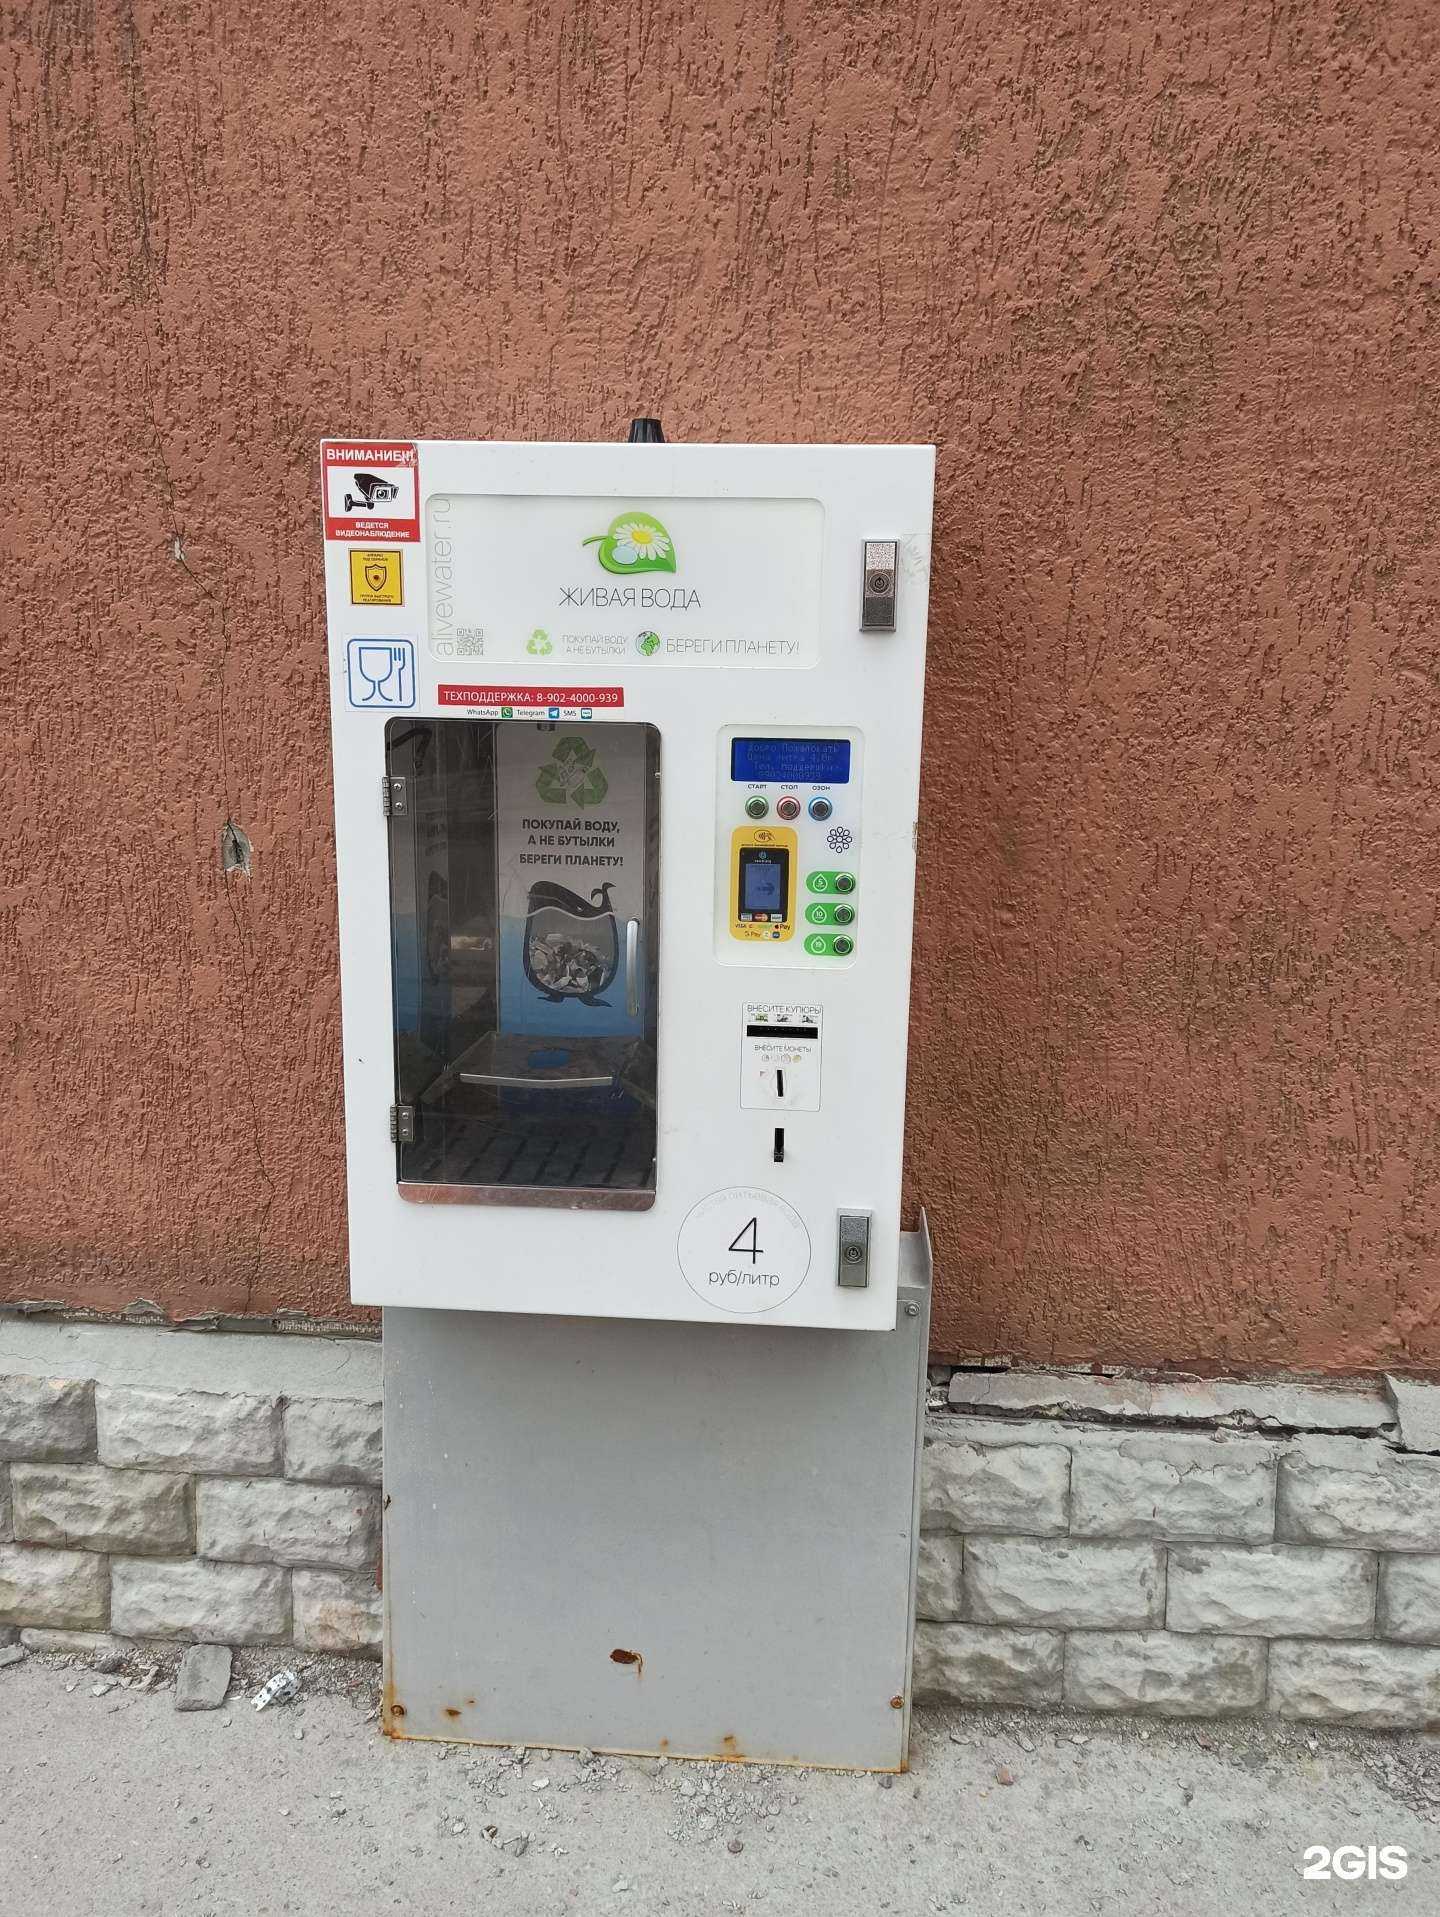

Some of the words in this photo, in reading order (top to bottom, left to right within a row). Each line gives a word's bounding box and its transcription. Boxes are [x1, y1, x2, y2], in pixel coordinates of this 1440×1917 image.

[355, 521, 389, 530] ВЕДЕТСЯ
[335, 529, 411, 539] ВИДЕОНАБЛЮДЕНИЕ
[432, 497, 453, 656] alivewater.ru
[558, 587, 636, 608] ЖИВАЯ
[641, 588, 702, 611] ВОДА
[562, 634, 604, 645] ПОКУПАЙ
[584, 647, 626, 655] БУТЫЛКИ
[666, 639, 723, 654] БЕРЕГИ
[725, 640, 799, 656] ПЛАНЕТУ!
[444, 691, 534, 703] ТЕХПОДДЕРЖКА:
[536, 692, 618, 703] 8-902-4000-939
[467, 709, 499, 717] WhatsApp
[517, 709, 545, 718] Telegram
[522, 817, 582, 830] ПОКУПАЙ
[584, 821, 620, 833] ВОДУ,
[528, 835, 536, 845] А
[539, 836, 555, 846] НЕ
[557, 836, 615, 848] БУТЫЛКИ
[519, 854, 562, 865] БЕРЕГИ
[564, 854, 624, 867] ПЛАНЕТУ!
[747, 1004, 785, 1013] ВНЕСИТЕ
[786, 1006, 822, 1015] КУПЮРЫ
[754, 1044, 782, 1052] ВНЕСИТЕ
[783, 1045, 812, 1053] МОНЕТЫ
[728, 1217, 764, 1265] 4
[708, 1270, 780, 1288] руб/литр
